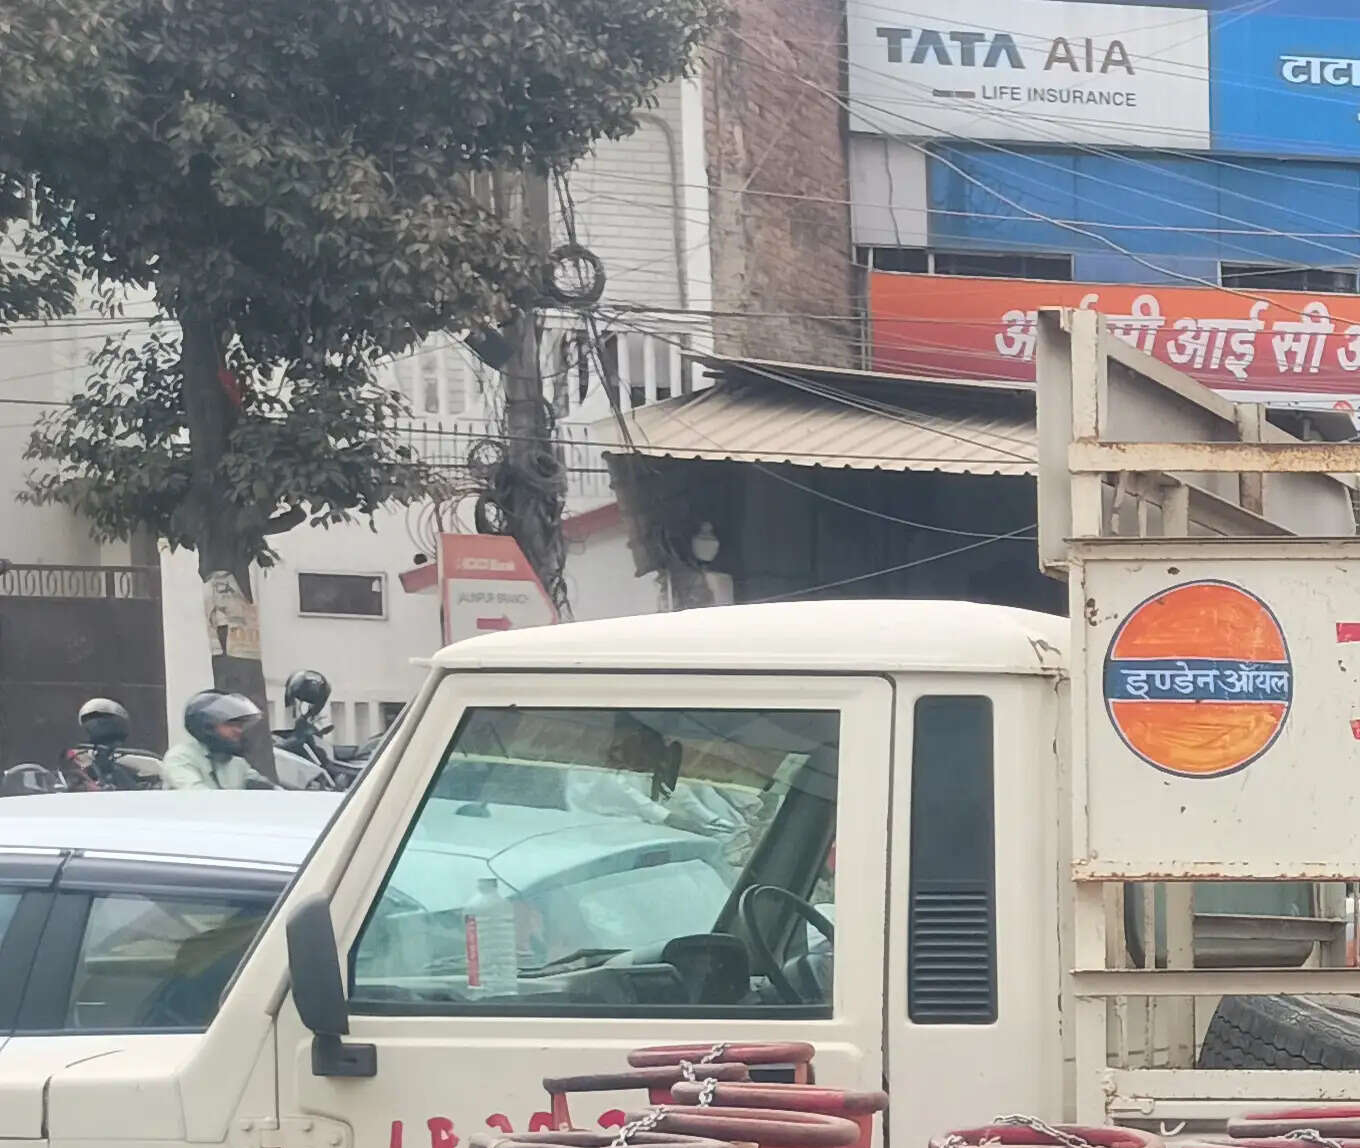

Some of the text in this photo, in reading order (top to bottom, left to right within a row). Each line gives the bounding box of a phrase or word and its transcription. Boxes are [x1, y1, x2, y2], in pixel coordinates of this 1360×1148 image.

[876, 27, 1135, 76] TATA AIA
[982, 85, 1137, 107] LIFE INSURANCE
[1166, 300, 1268, 380] आई
[1271, 302, 1341, 374] सी
[1121, 659, 1291, 698] इण्डेन ऑयल
